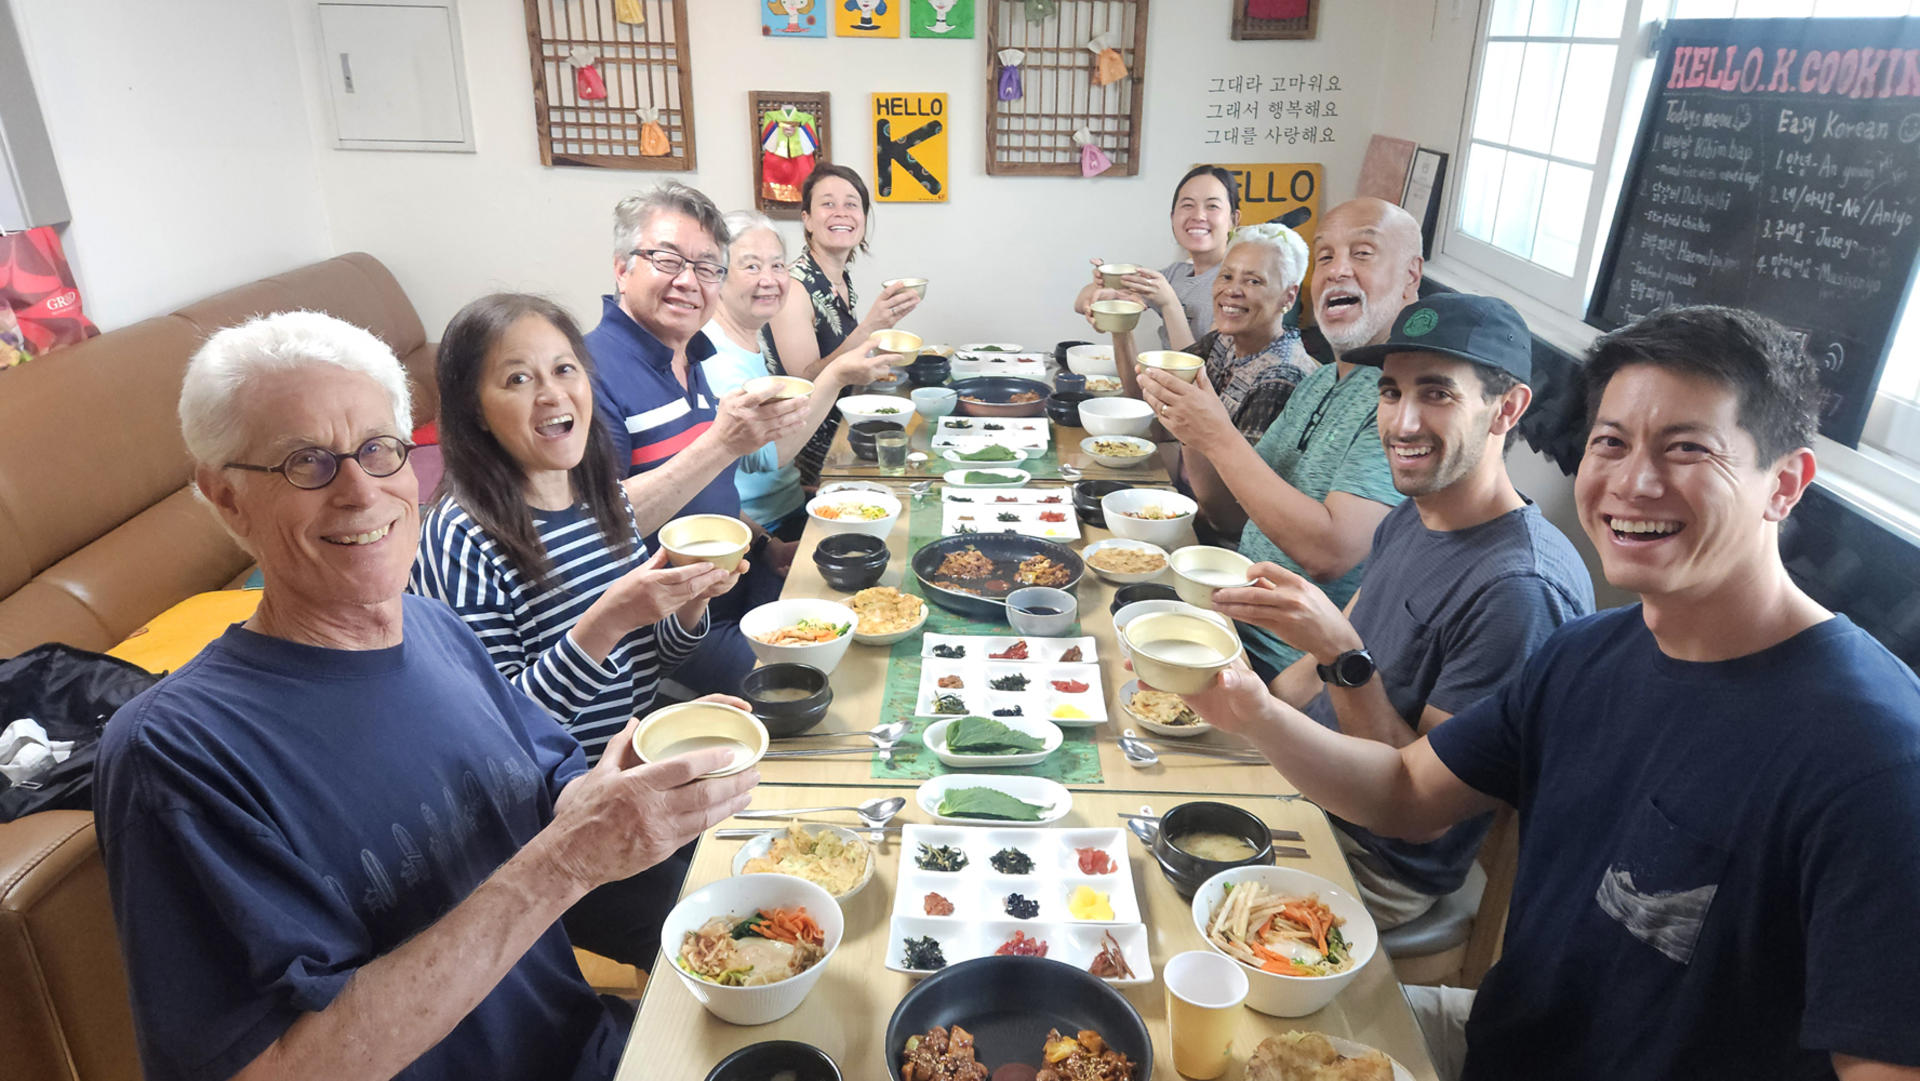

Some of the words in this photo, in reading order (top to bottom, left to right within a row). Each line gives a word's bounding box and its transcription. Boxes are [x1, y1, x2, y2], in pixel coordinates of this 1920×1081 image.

[1208, 74, 1263, 94] 그대라
[1269, 73, 1343, 94] 고마워요
[876, 97, 944, 116] HELLO
[1206, 100, 1259, 120] 그래서
[1268, 99, 1339, 120] 행복해요
[1204, 126, 1258, 146] 그대를
[1265, 125, 1336, 145] 사랑해요
[1777, 107, 1817, 144] Easy
[1822, 108, 1889, 141] Korean
[876, 118, 944, 197] K
